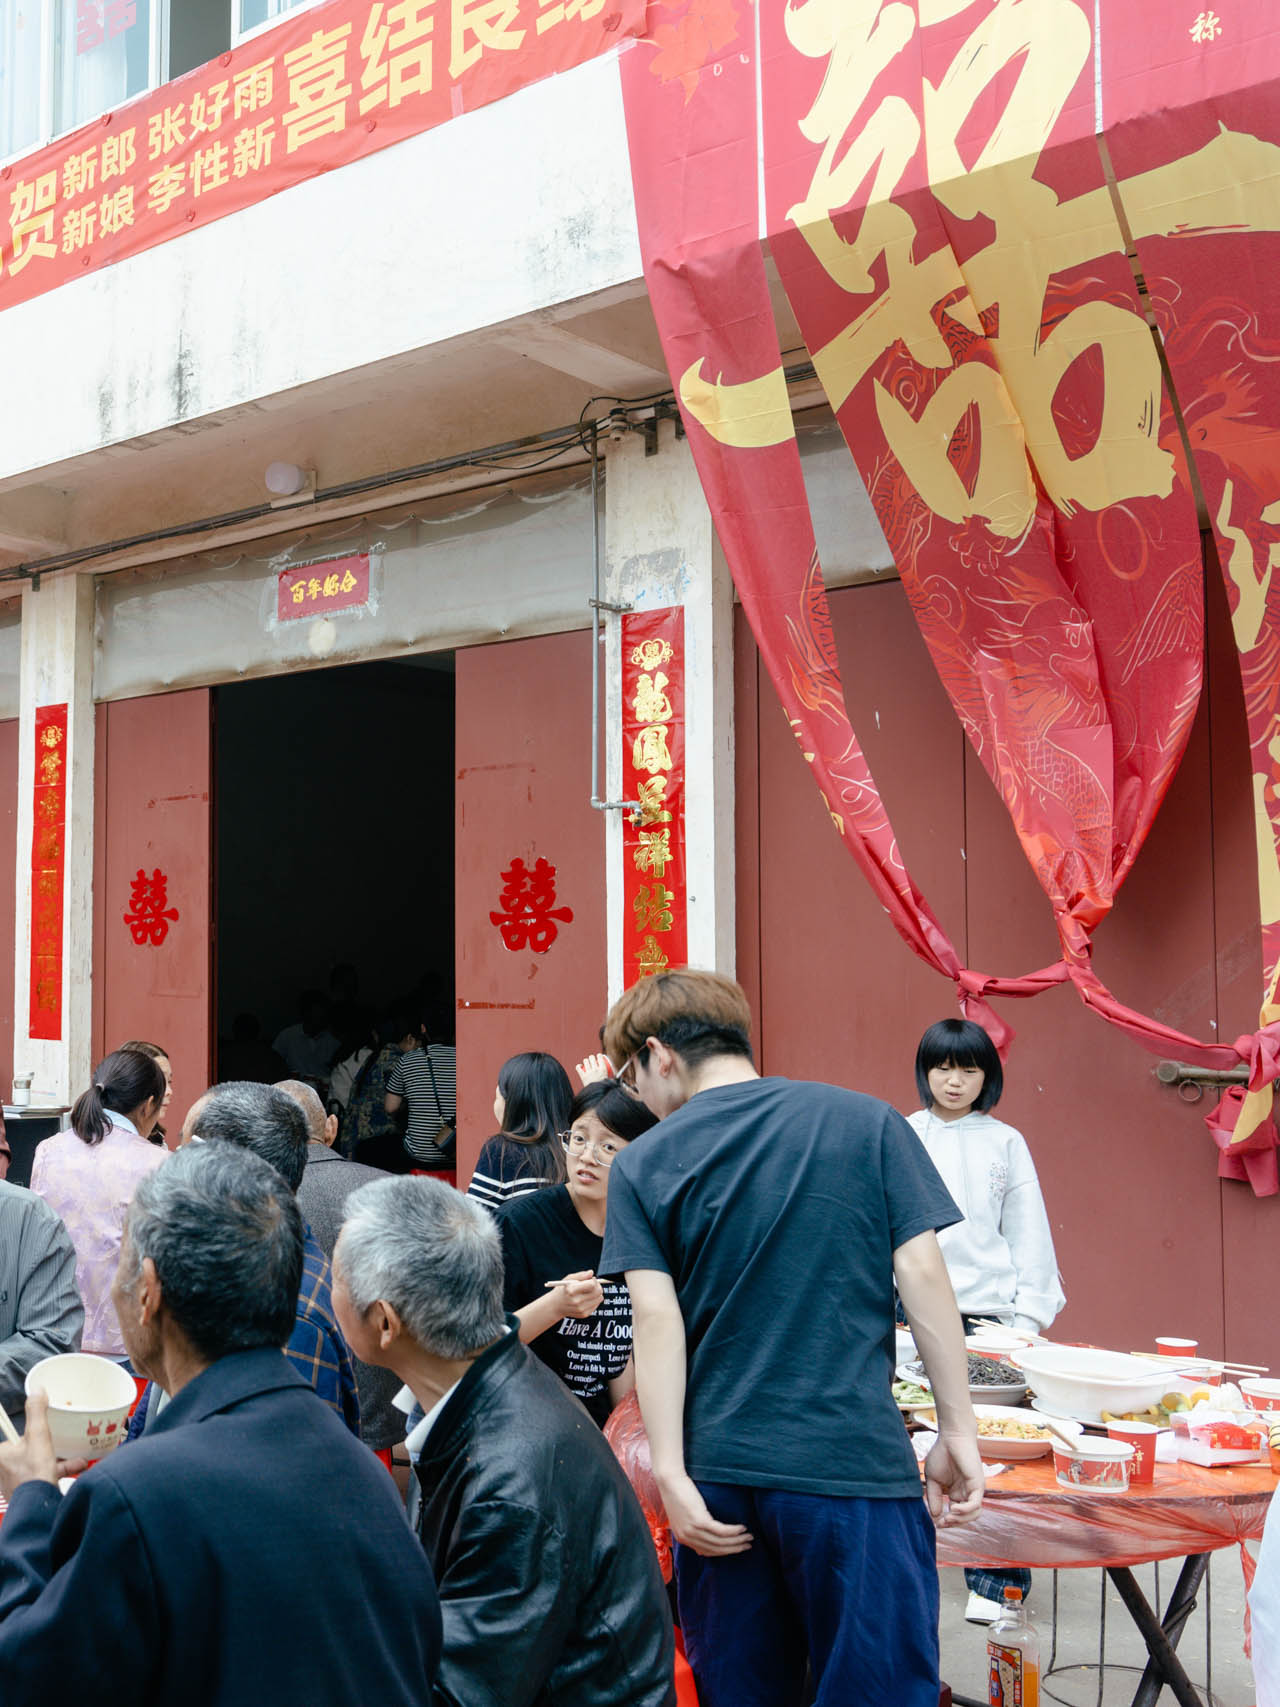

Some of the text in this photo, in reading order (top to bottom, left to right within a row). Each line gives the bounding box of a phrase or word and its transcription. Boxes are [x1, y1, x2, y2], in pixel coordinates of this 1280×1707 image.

[62, 56, 275, 200] 新郎 张好雨
[61, 117, 276, 255] 新娘 李性新
[290, 569, 358, 604] 百年好合
[558, 1317, 590, 1337] Have
[591, 1321, 601, 1338] A
[567, 1350, 580, 1360] Our
[569, 1362, 584, 1371] Love
